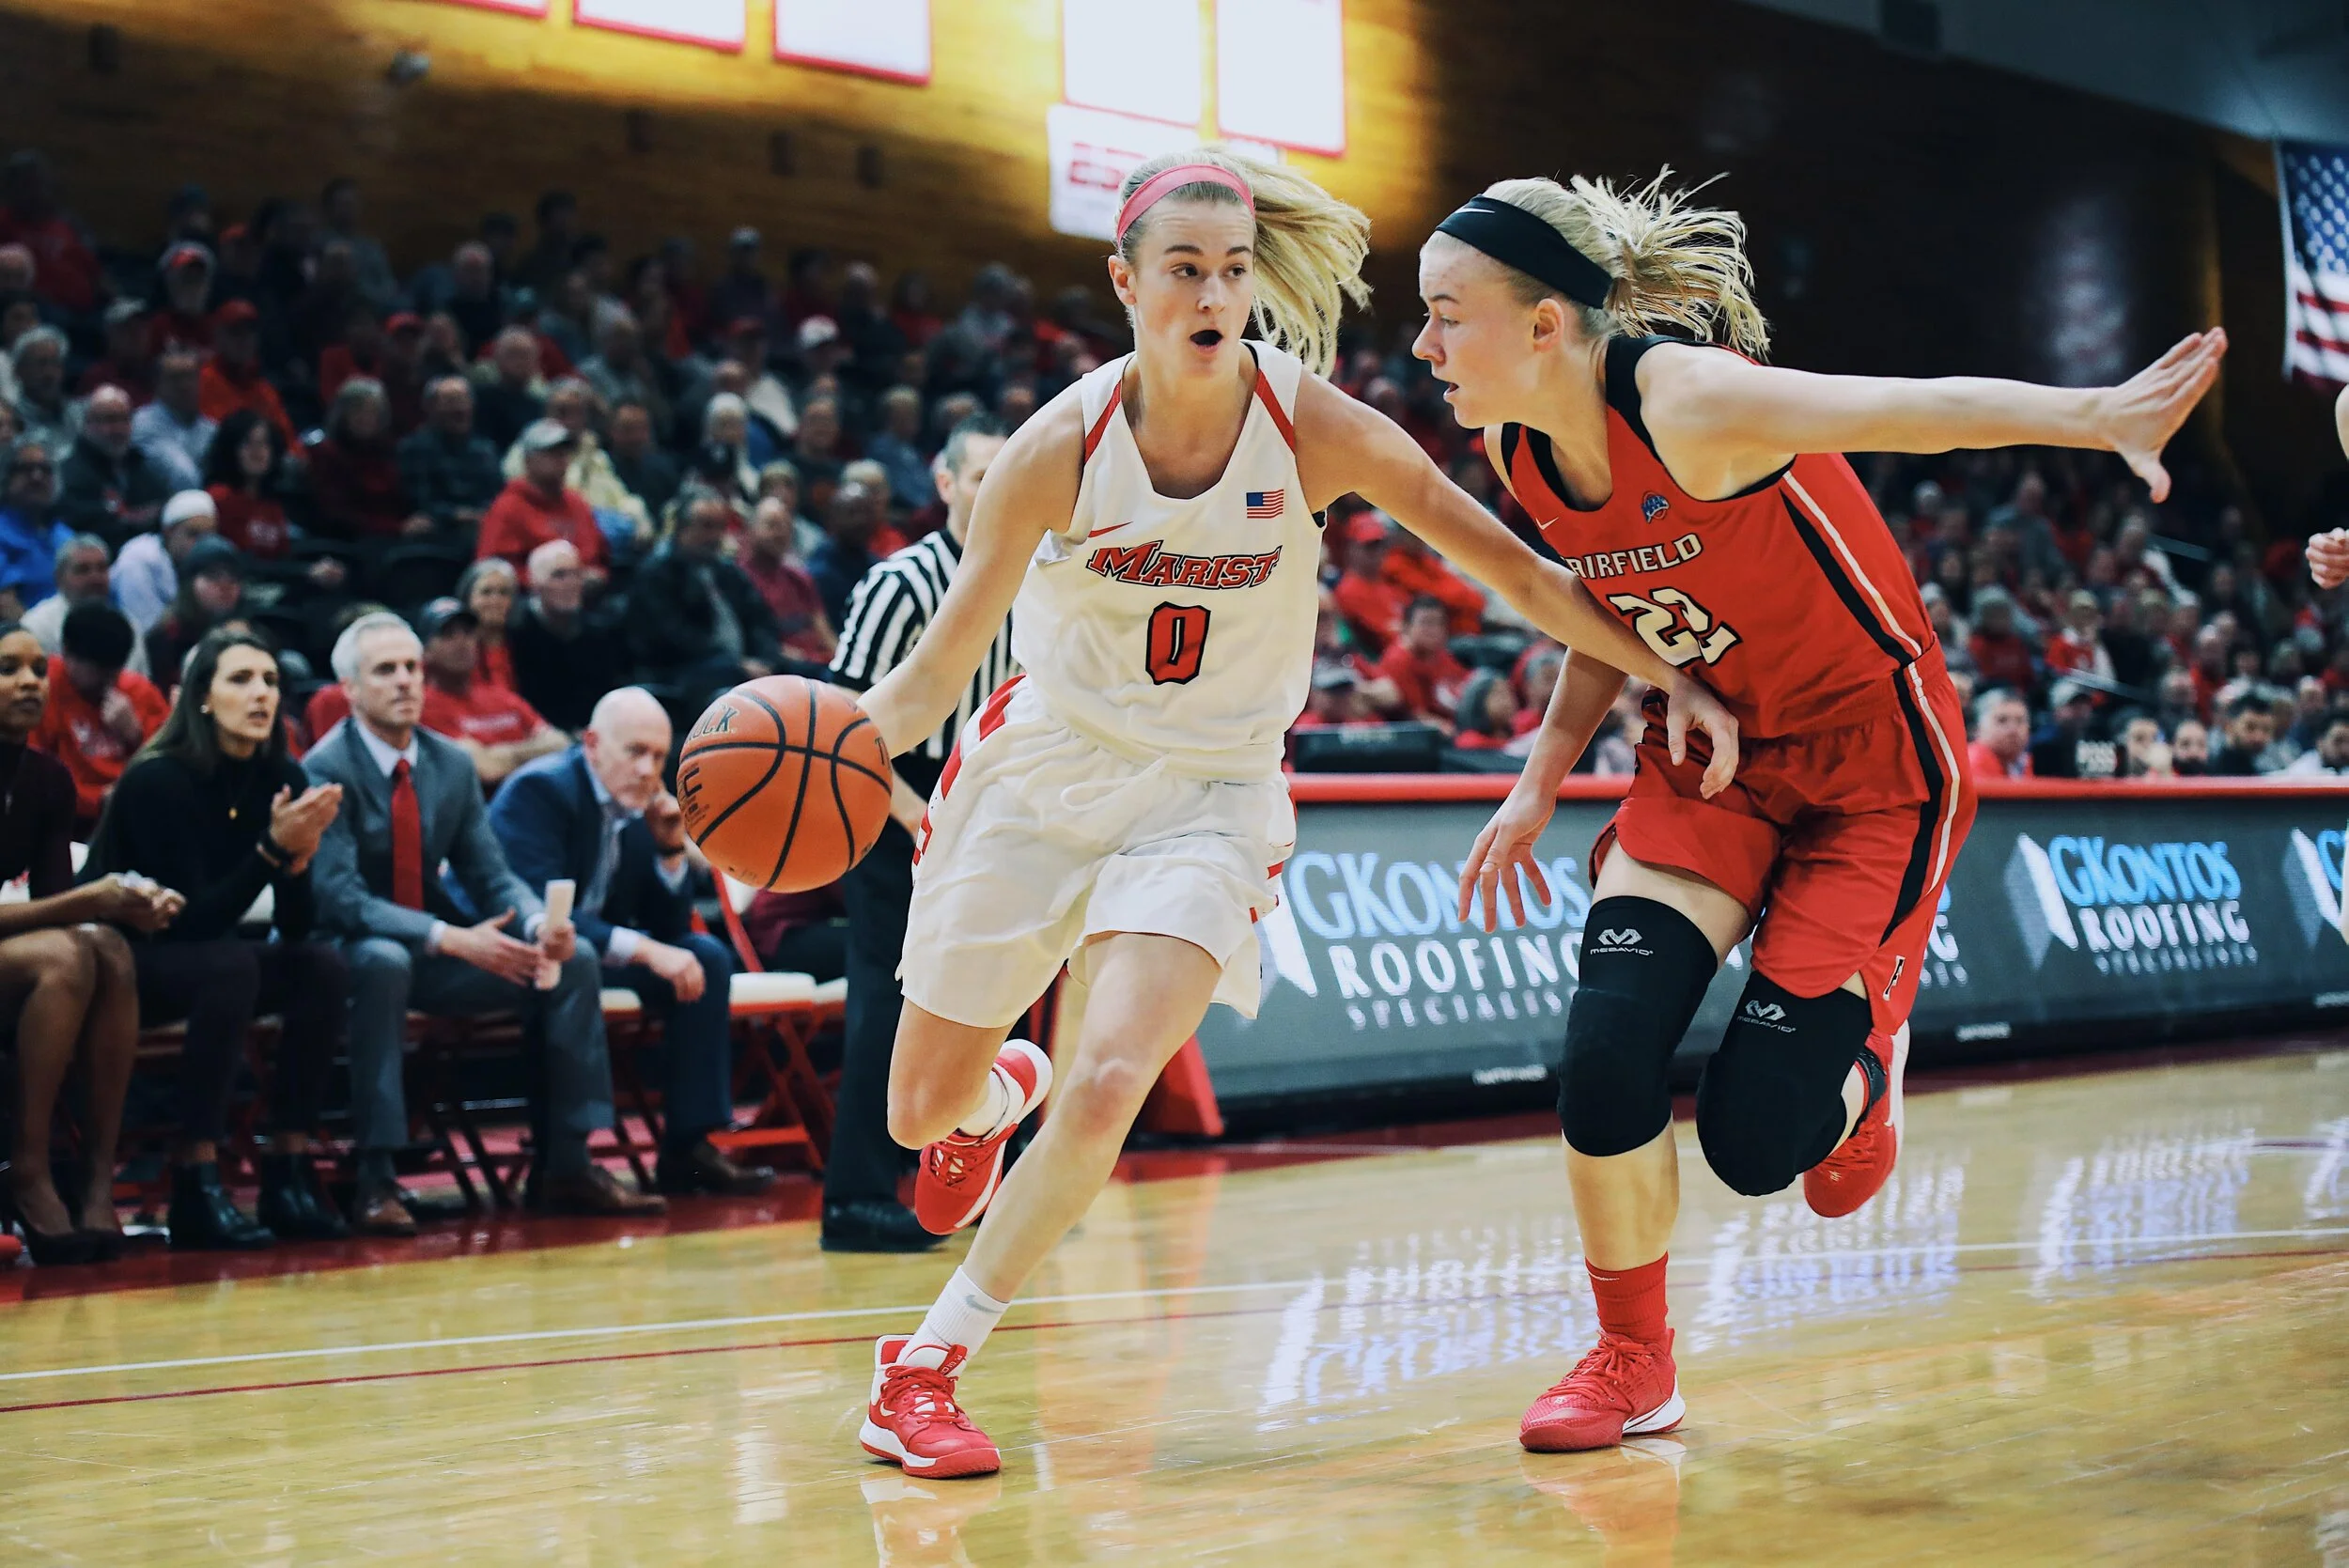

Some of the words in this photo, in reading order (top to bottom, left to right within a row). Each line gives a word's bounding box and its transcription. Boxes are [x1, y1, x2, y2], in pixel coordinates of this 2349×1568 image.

[1561, 533, 1703, 580] AIRFIELD
[1145, 601, 1211, 685] 0
[1606, 586, 1743, 668] 22
[2078, 899, 2250, 952] ROOFING
